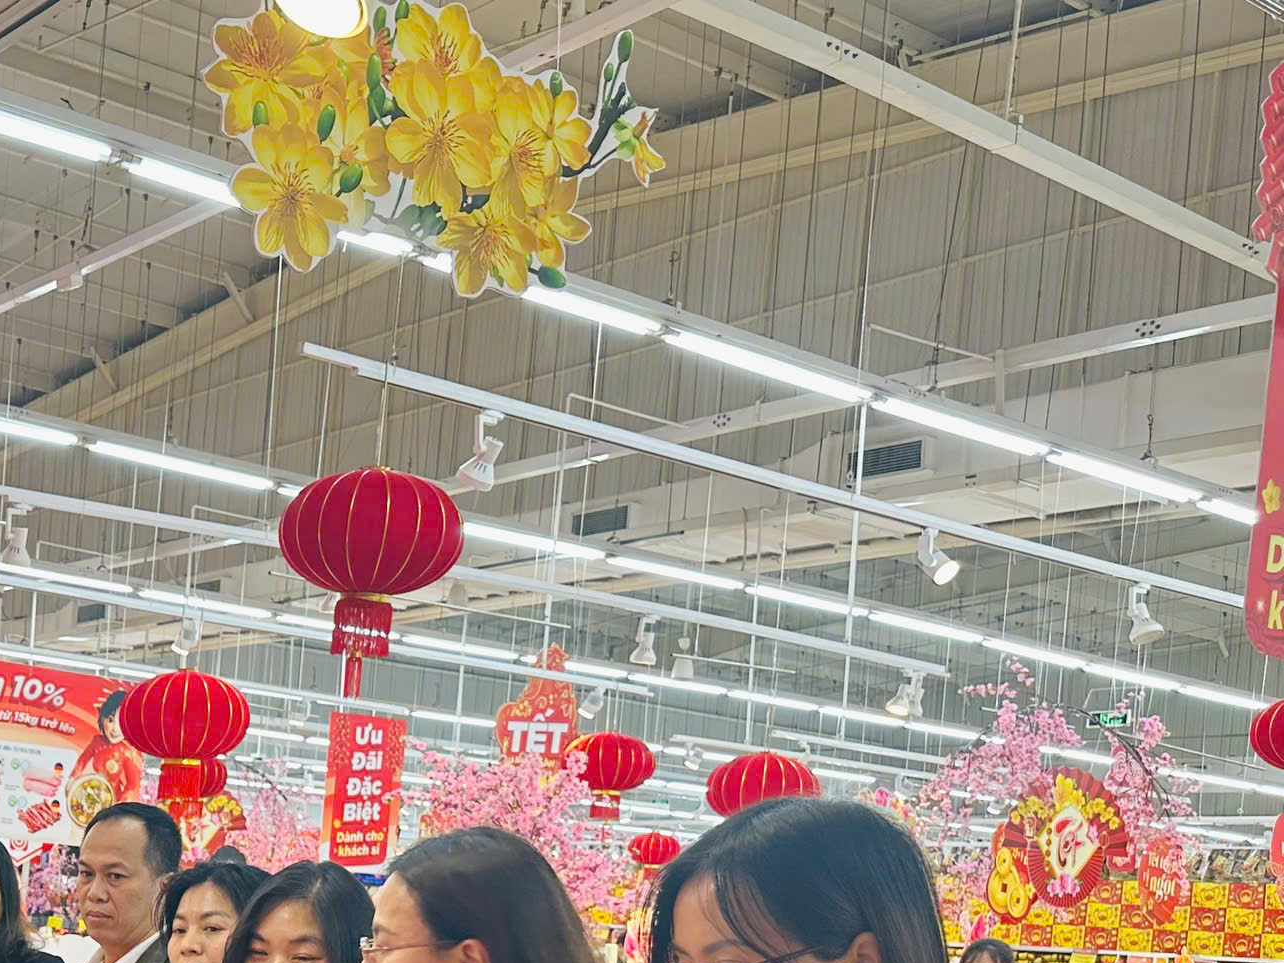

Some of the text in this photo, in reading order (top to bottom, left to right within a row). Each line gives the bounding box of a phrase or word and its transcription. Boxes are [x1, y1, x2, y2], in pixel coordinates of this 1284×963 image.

[1266, 534, 1284, 573] D
[1267, 589, 1284, 630] k
[12, 674, 66, 707] 10%
[14, 710, 39, 726] 15kg
[40, 716, 59, 729] trở
[59, 721, 76, 735] lên
[355, 723, 383, 745] Ưu
[507, 707, 569, 754] TẾT
[351, 750, 382, 771] Đãi
[346, 776, 382, 800] Đặc
[342, 801, 381, 825] Biệt
[336, 829, 384, 843] Dành cho
[338, 844, 369, 857] khách
